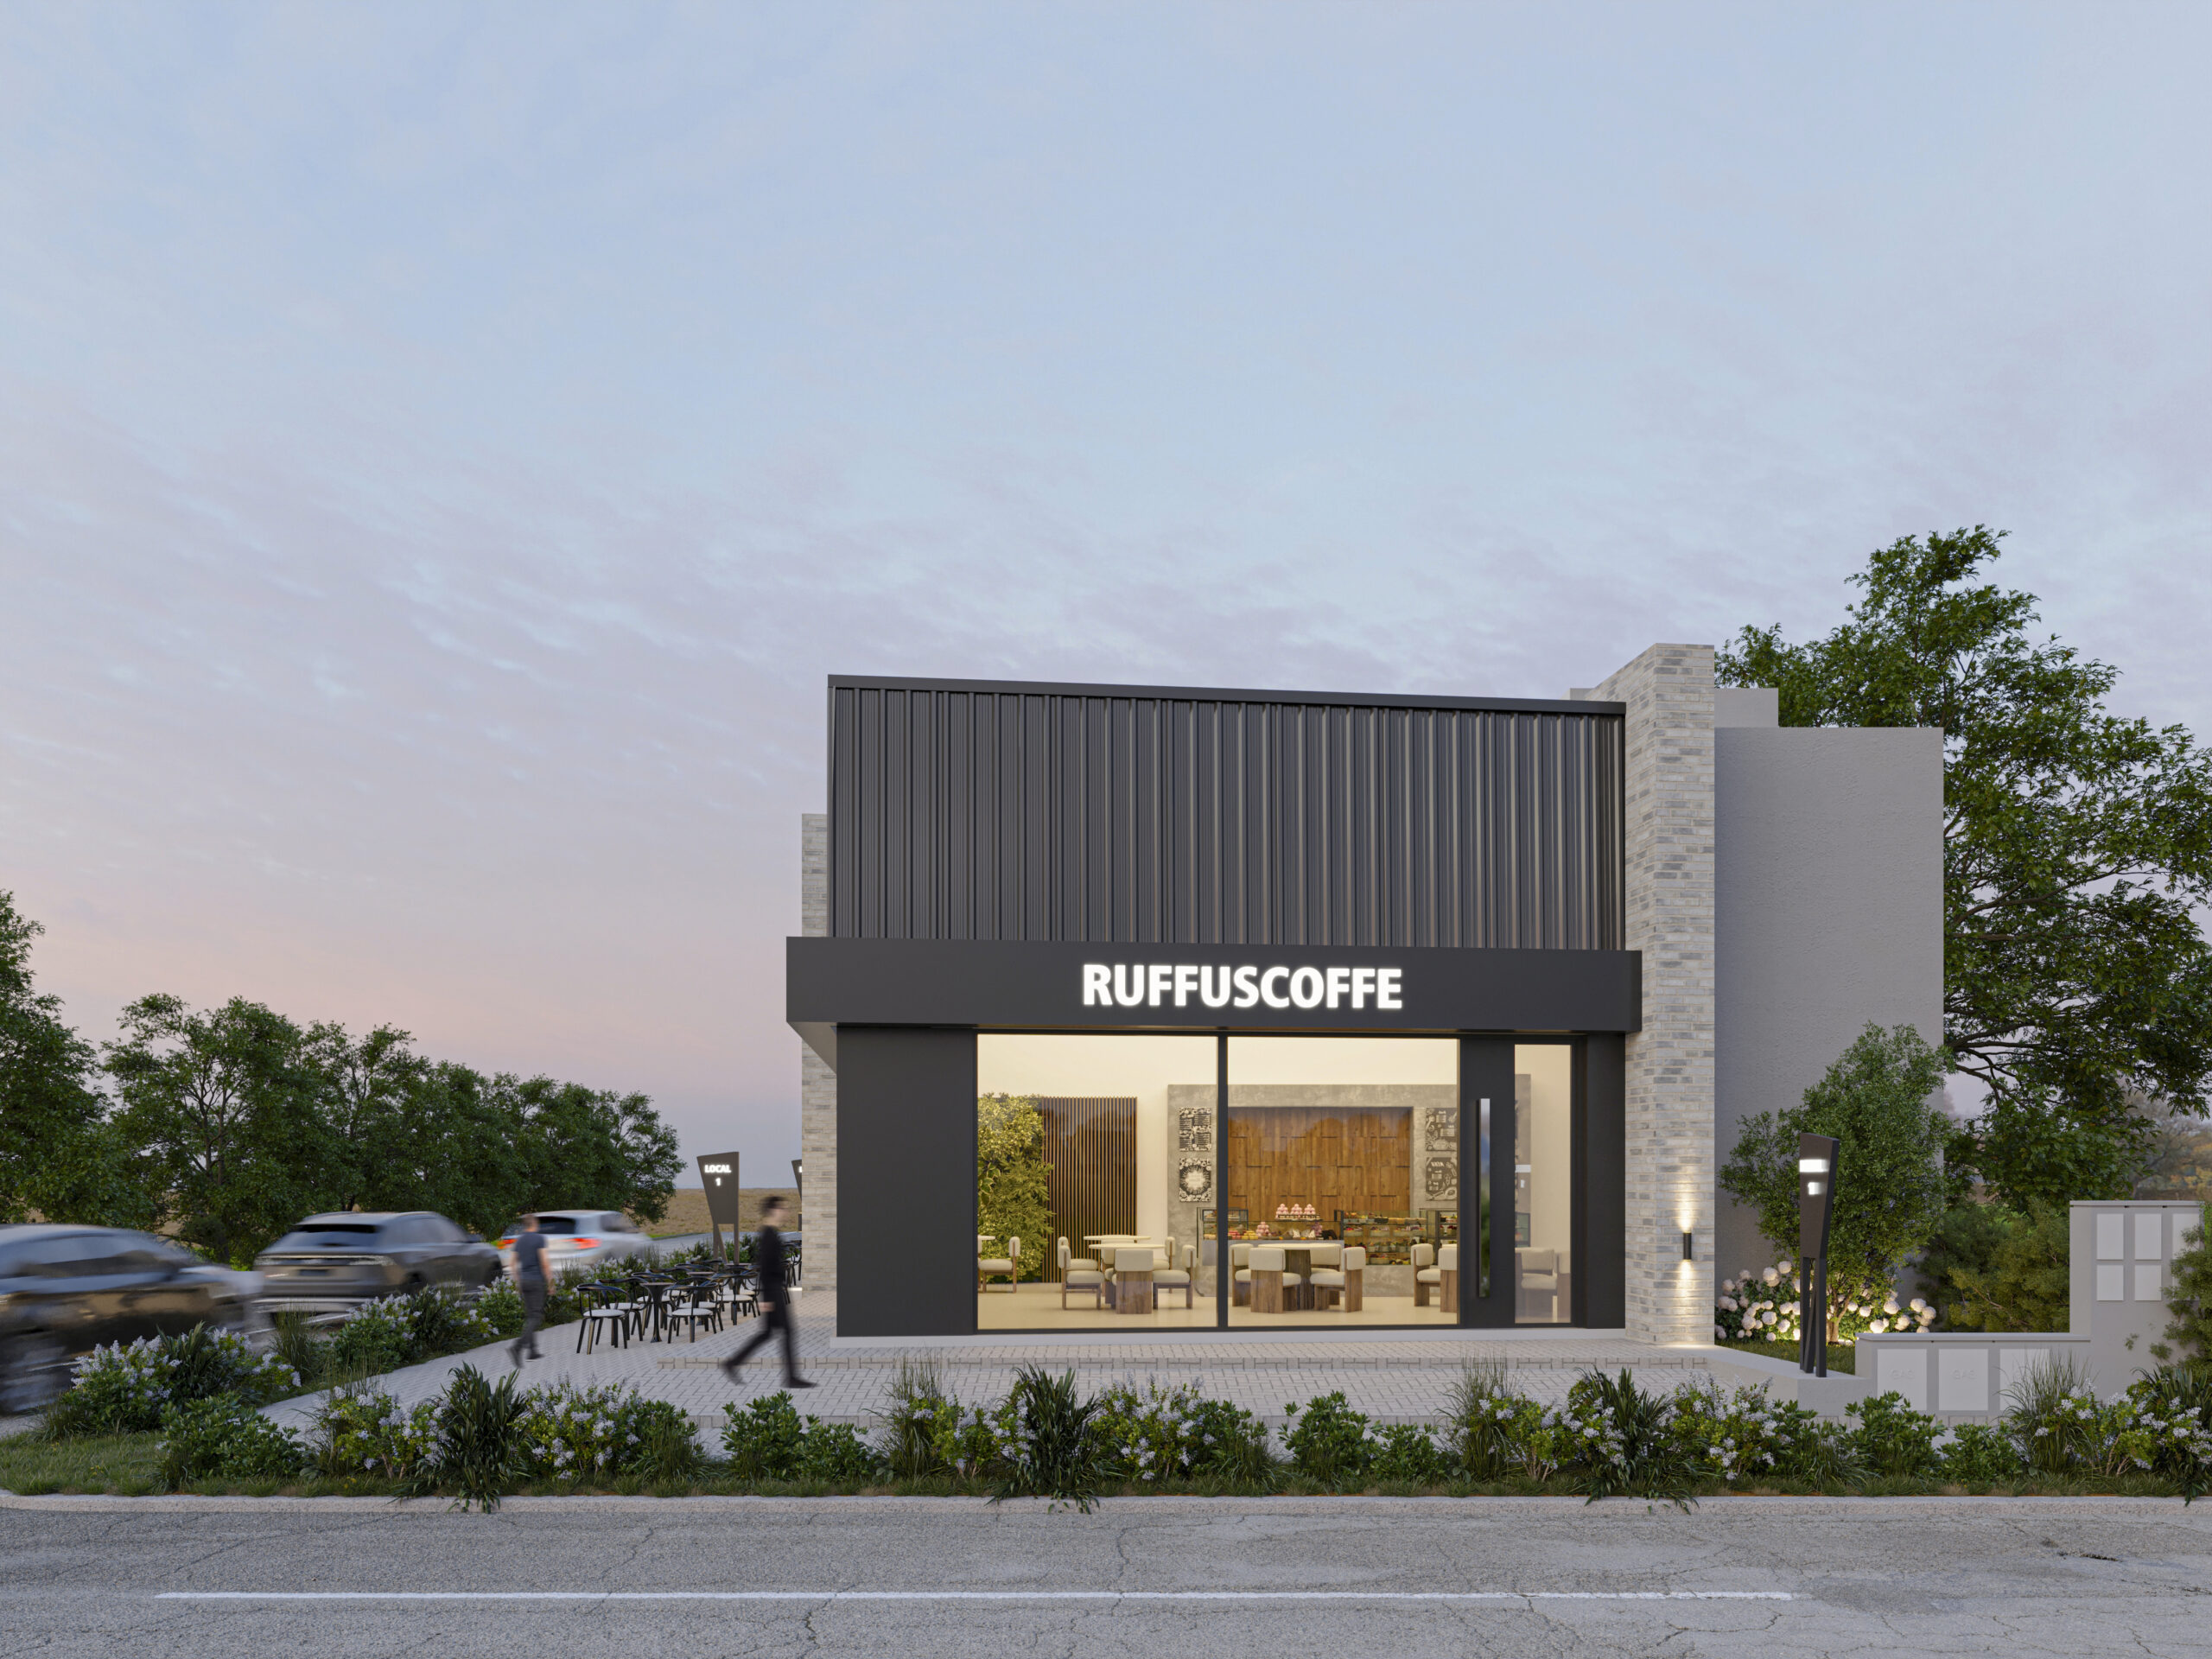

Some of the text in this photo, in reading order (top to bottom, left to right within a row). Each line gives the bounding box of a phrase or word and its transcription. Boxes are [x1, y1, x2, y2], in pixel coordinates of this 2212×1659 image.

[1083, 963, 1402, 1009] RUFFUSCOFFE
[704, 1164, 732, 1173] LOCAL
[715, 1177, 721, 1186] 1
